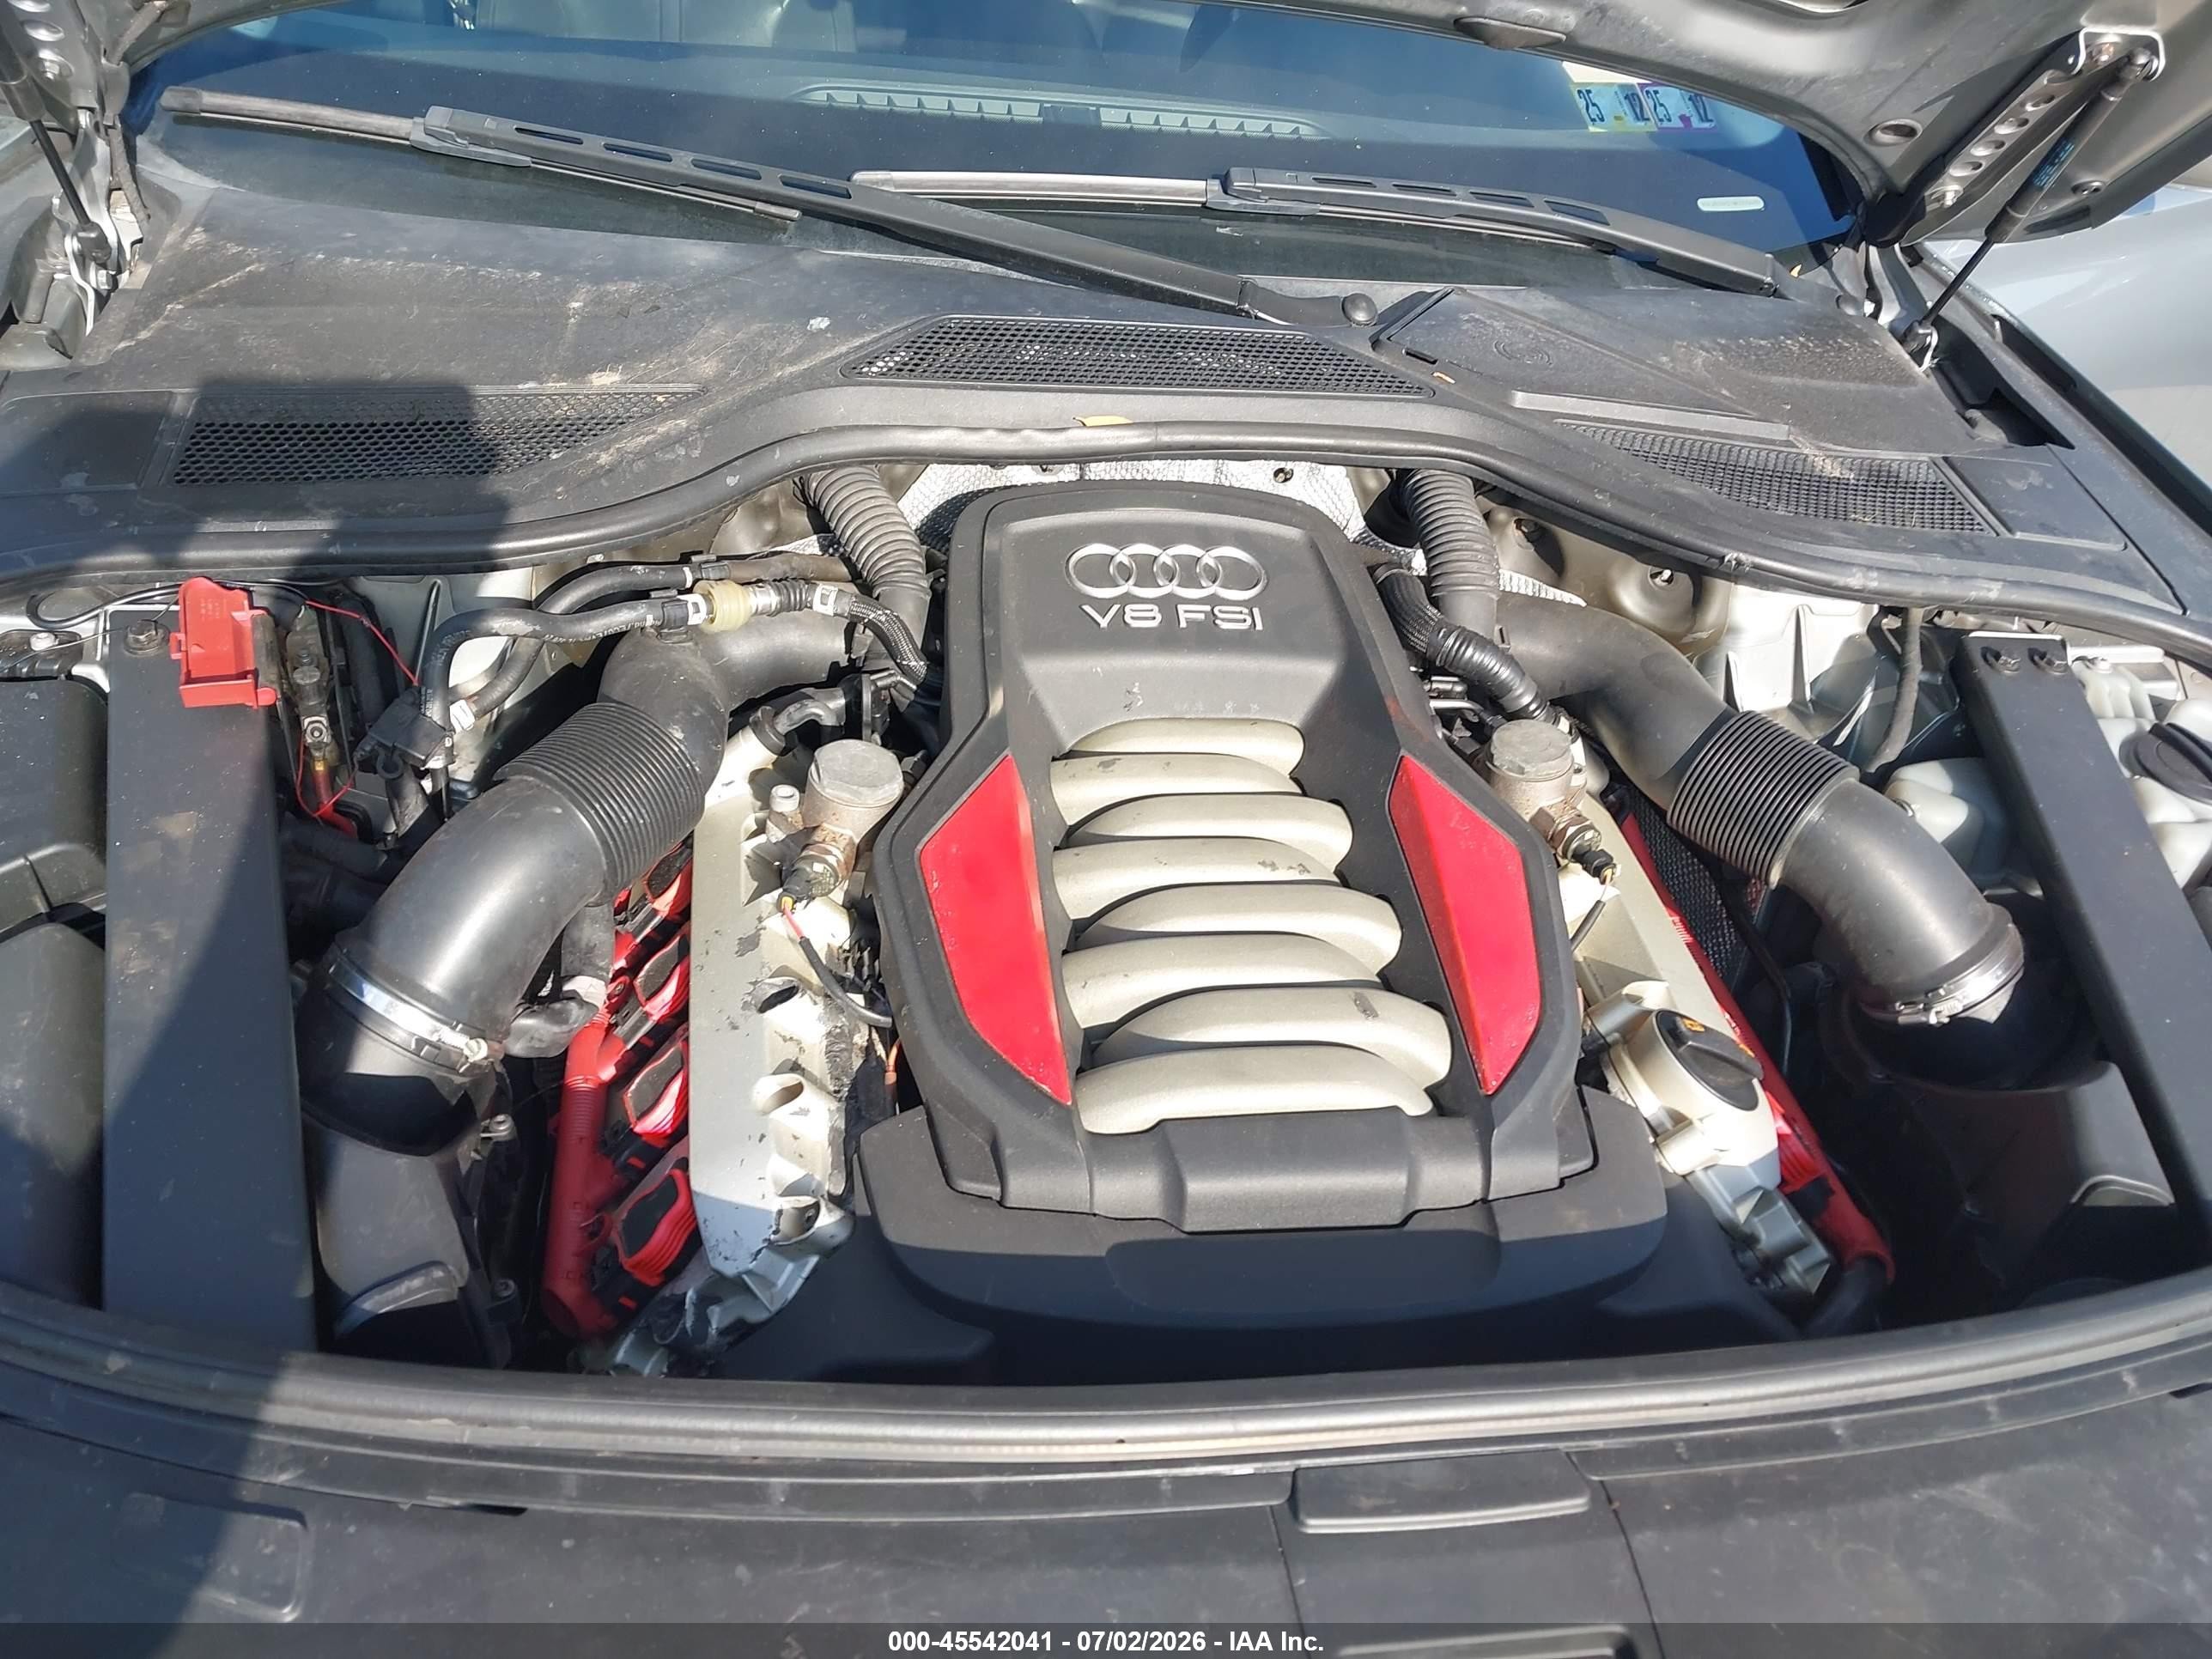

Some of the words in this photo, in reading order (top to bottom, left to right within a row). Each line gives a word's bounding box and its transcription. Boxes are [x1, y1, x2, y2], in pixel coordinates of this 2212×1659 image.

[1577, 89, 1605, 122] 25
[1624, 92, 1650, 121] 12
[1644, 89, 1673, 122] 25
[1688, 94, 1714, 122] 12
[1080, 604, 1161, 629] V8
[1176, 605, 1263, 631] FSI
